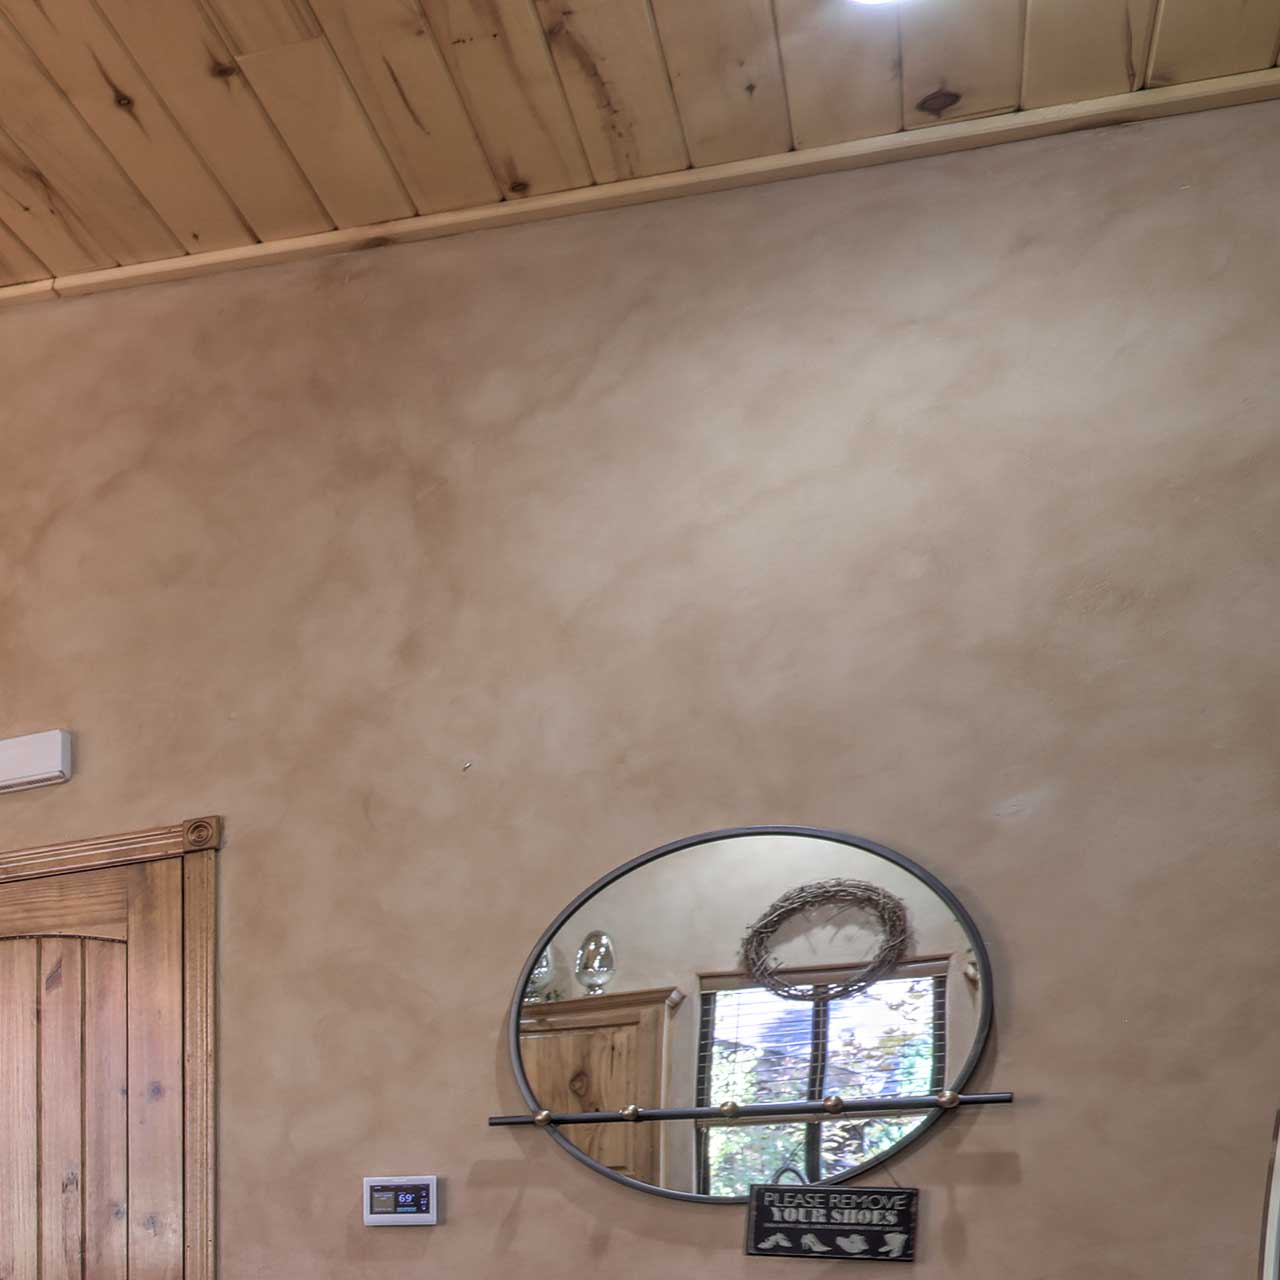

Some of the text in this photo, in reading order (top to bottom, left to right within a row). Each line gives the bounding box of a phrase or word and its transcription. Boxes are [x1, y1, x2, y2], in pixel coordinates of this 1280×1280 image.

[764, 1192, 907, 1210] PLEASE REMOVE
[770, 1206, 899, 1225] YOUR SHOES
